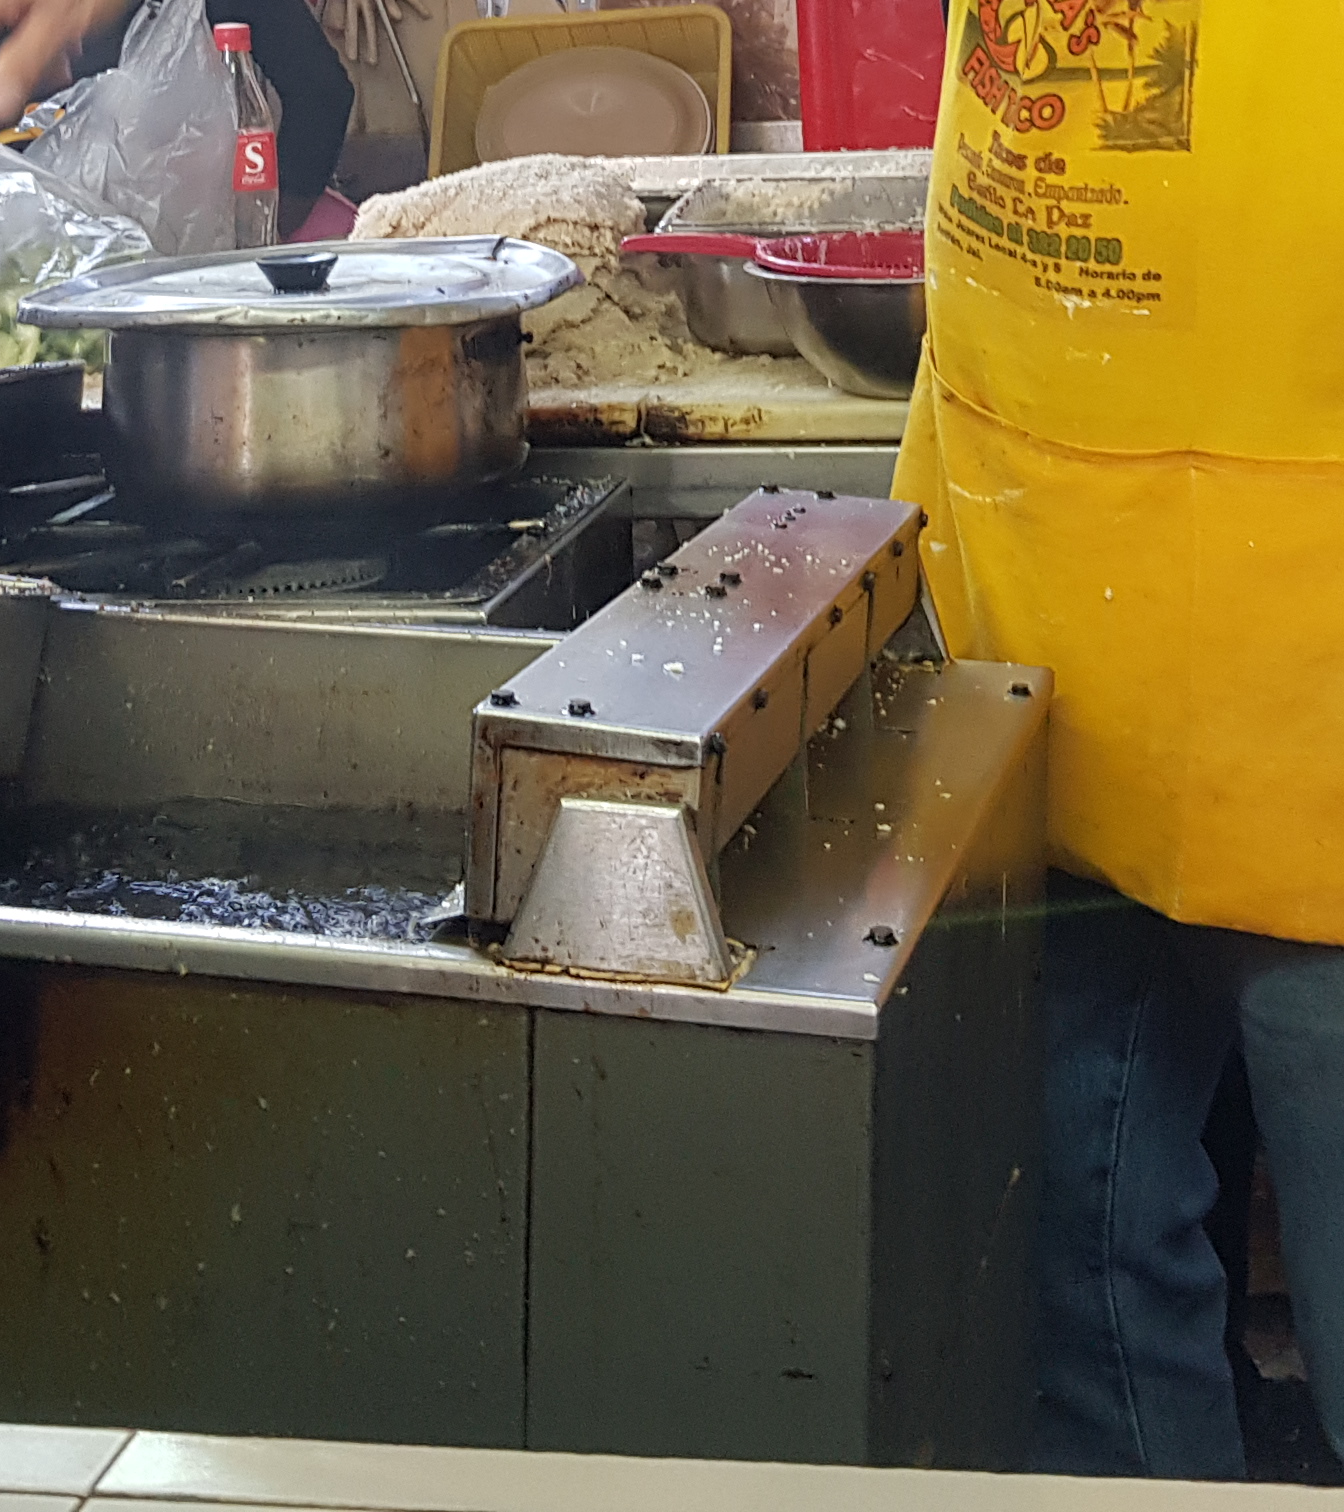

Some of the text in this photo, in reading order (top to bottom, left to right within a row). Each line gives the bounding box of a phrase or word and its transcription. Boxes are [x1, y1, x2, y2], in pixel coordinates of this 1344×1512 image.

[245, 142, 264, 174] S
[1034, 152, 1066, 176] de
[1093, 237, 1123, 266] 50
[1078, 266, 1138, 282] Horario
[1141, 268, 1163, 282] de
